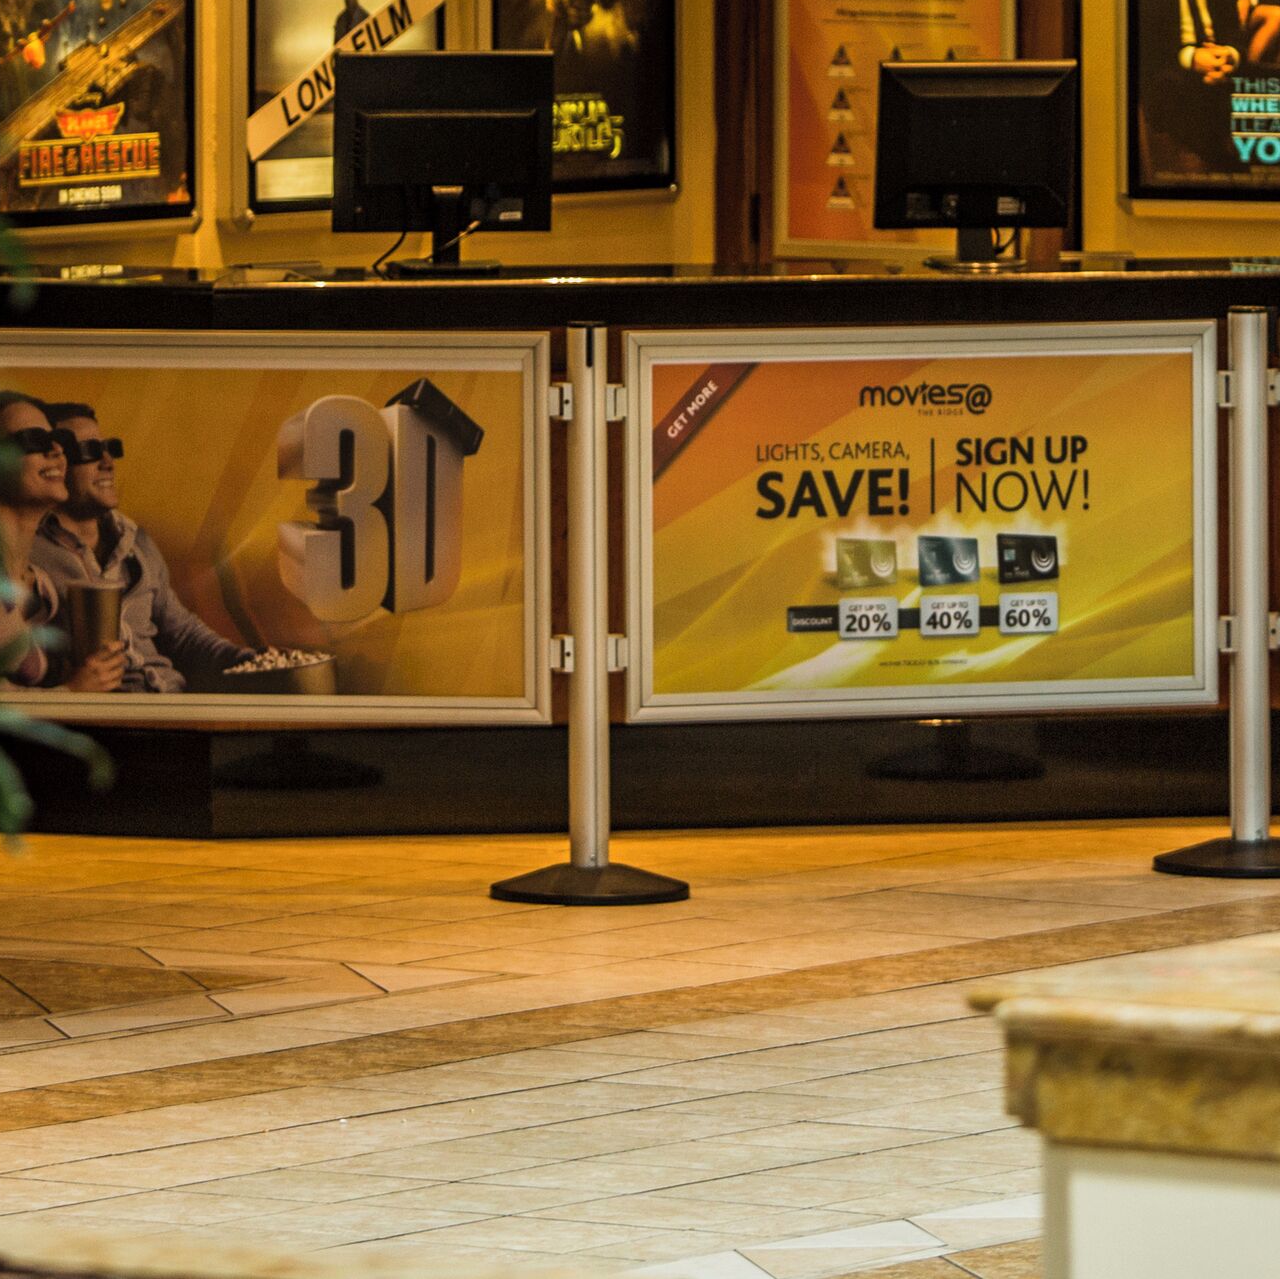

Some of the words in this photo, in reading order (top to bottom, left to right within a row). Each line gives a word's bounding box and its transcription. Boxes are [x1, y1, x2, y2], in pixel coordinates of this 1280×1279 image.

[280, 57, 335, 127] LON
[1232, 77, 1280, 93] THIS
[19, 144, 65, 179] FIRE
[80, 138, 161, 174] RESCUE
[666, 412, 688, 438] GET
[686, 379, 719, 416] MORE
[858, 381, 992, 415] movies@
[755, 441, 826, 465] LIGHTS,
[828, 439, 911, 461] CAMERA,
[954, 436, 1035, 467] SIGN
[1044, 435, 1089, 465] UP
[277, 394, 466, 622] 3D
[754, 468, 911, 519] SAVE!
[955, 468, 1092, 514] NOW!
[845, 613, 892, 633] 20%
[925, 611, 973, 630] 40%
[1005, 609, 1052, 628] 60%
